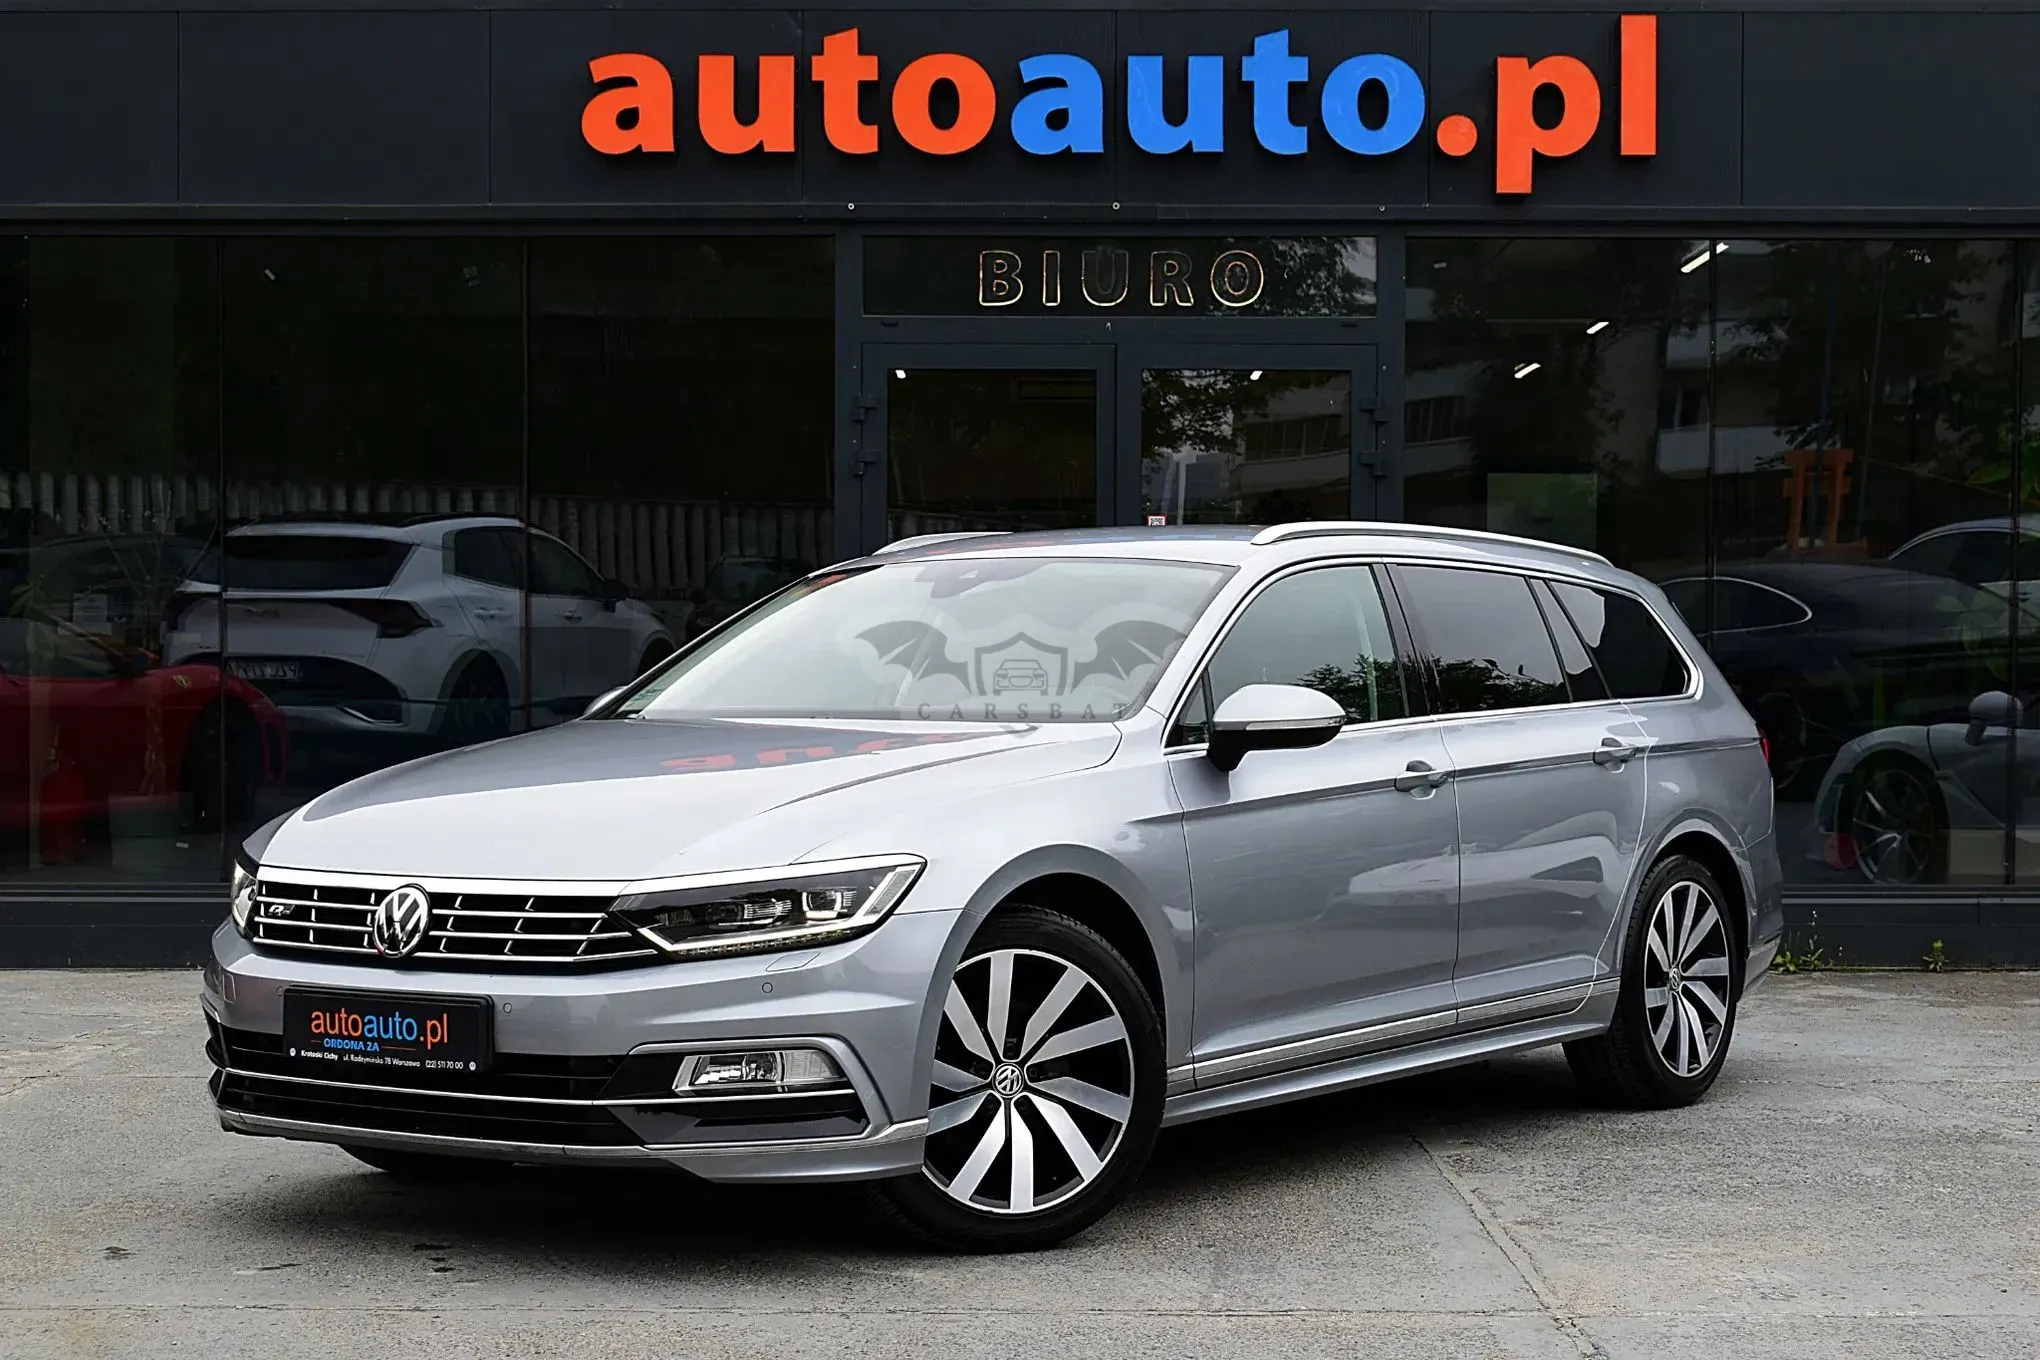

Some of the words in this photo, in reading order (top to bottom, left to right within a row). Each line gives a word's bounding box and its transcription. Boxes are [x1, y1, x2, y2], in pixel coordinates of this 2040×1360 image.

[580, 13, 1659, 195] autoauto.pl
[977, 246, 1265, 307] BIURO
[310, 1007, 448, 1050] autoauto.pl
[323, 1038, 365, 1051] ORDONA
[366, 1041, 380, 1052] 2A
